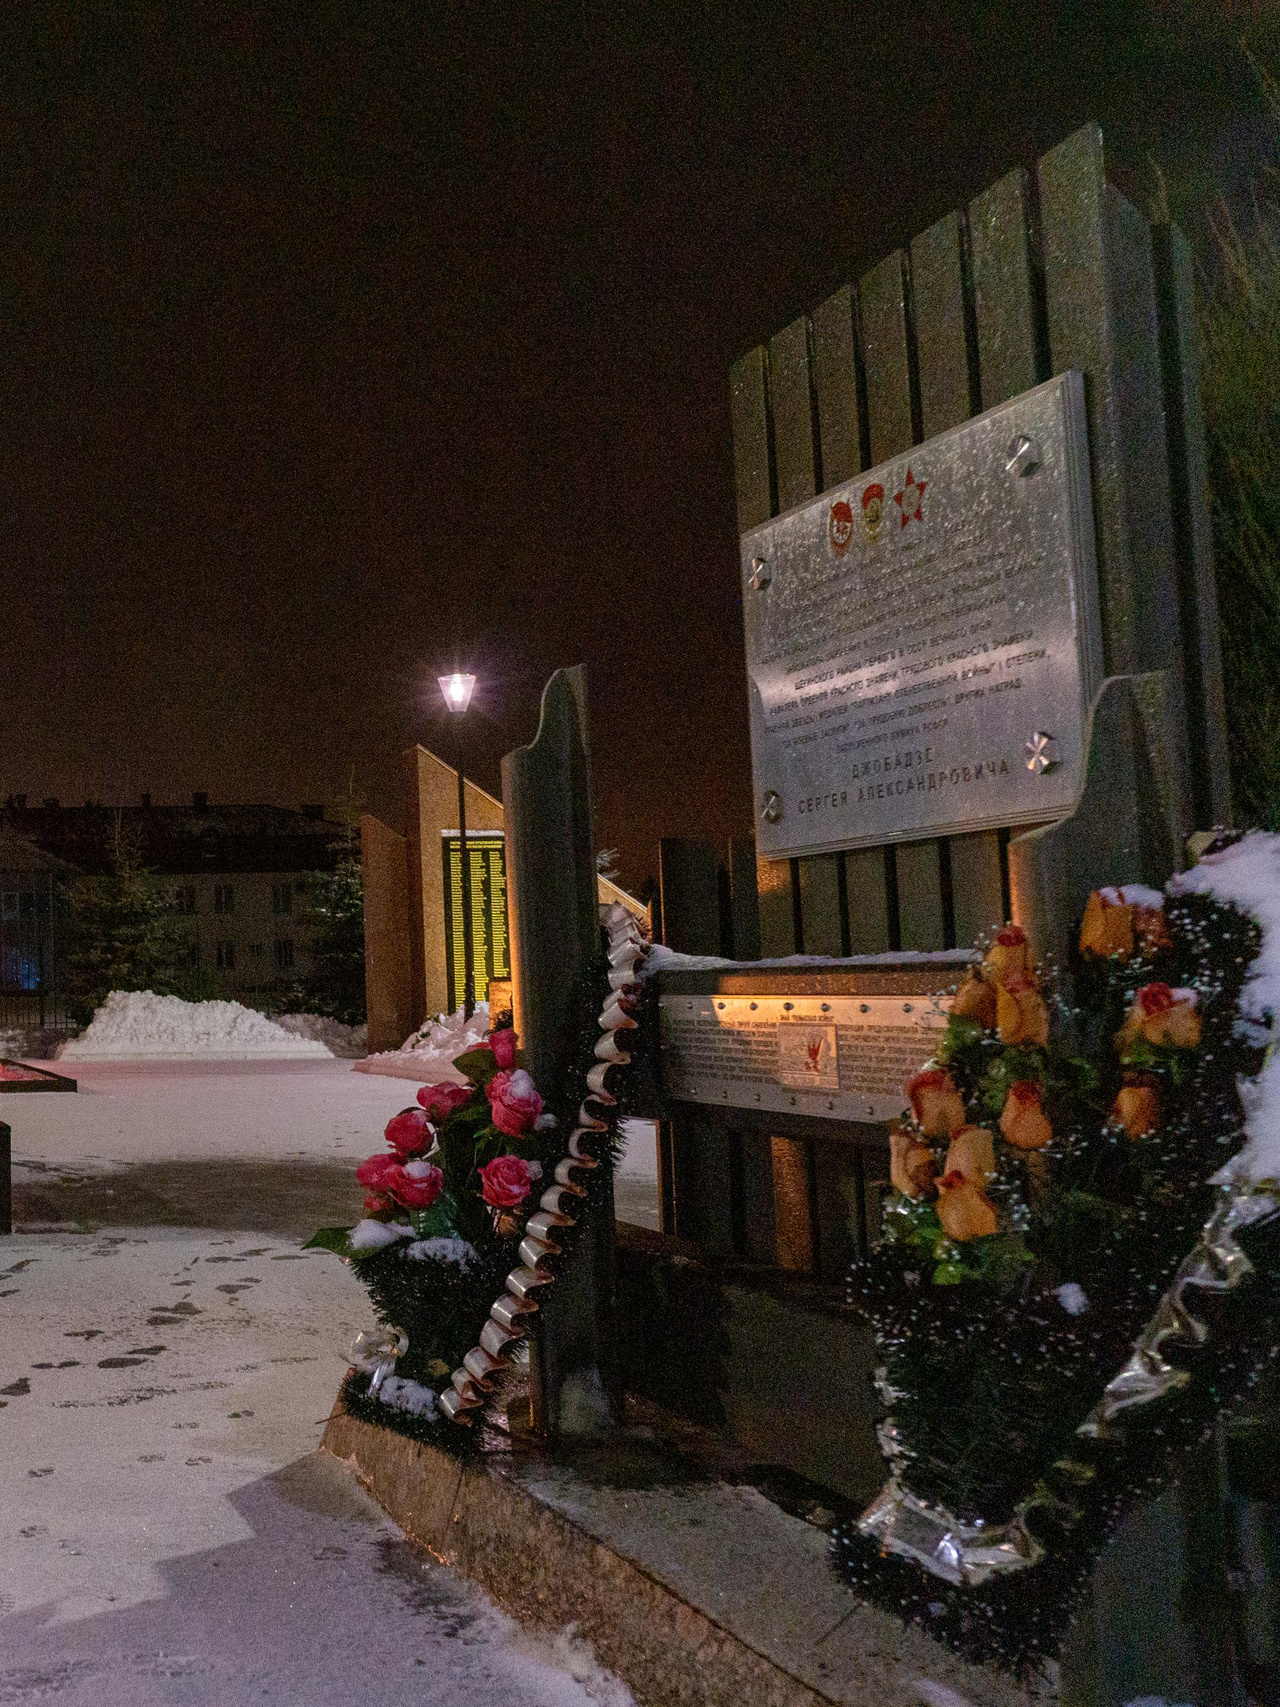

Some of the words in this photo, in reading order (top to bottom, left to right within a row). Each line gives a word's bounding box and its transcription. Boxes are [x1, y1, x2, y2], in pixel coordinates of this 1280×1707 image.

[798, 789, 848, 815] СЕРГЕЯ
[856, 755, 1011, 806] АЛЕКСАНДРОВИЧА
[851, 745, 934, 780] ДЖОБАДЗЕ
